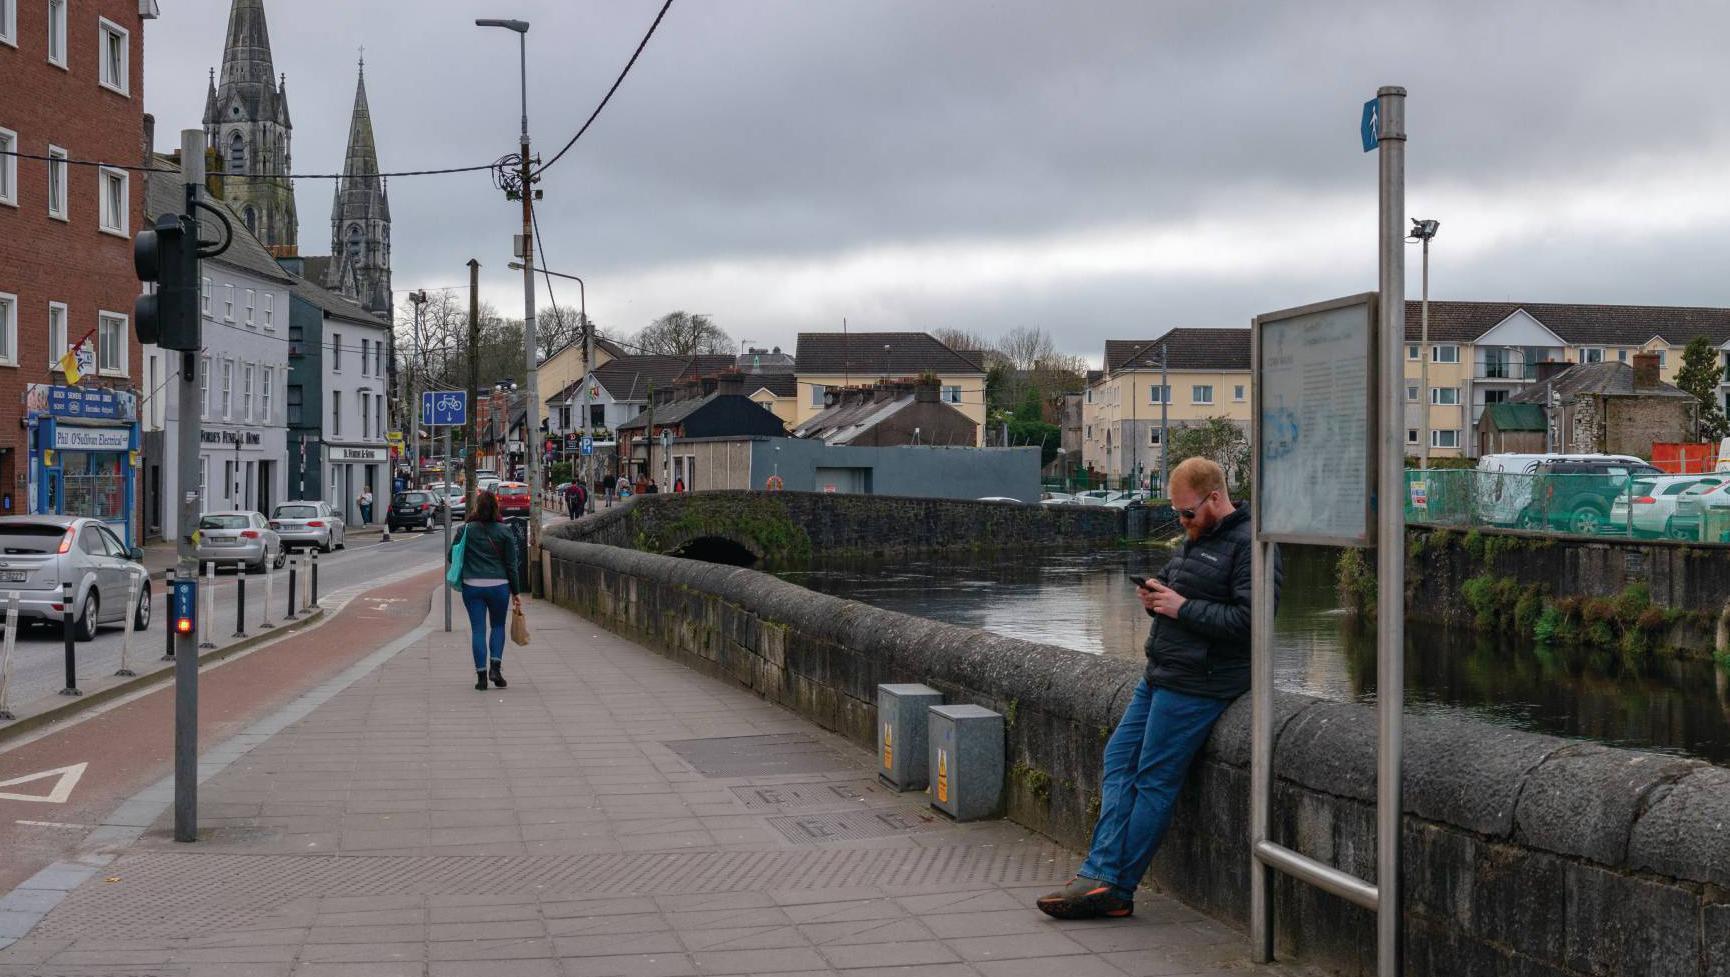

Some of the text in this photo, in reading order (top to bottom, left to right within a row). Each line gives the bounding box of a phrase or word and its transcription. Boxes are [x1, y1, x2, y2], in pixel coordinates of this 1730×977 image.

[57, 432, 122, 446] Phil O'Sullivan Electrical
[583, 438, 590, 449] P
